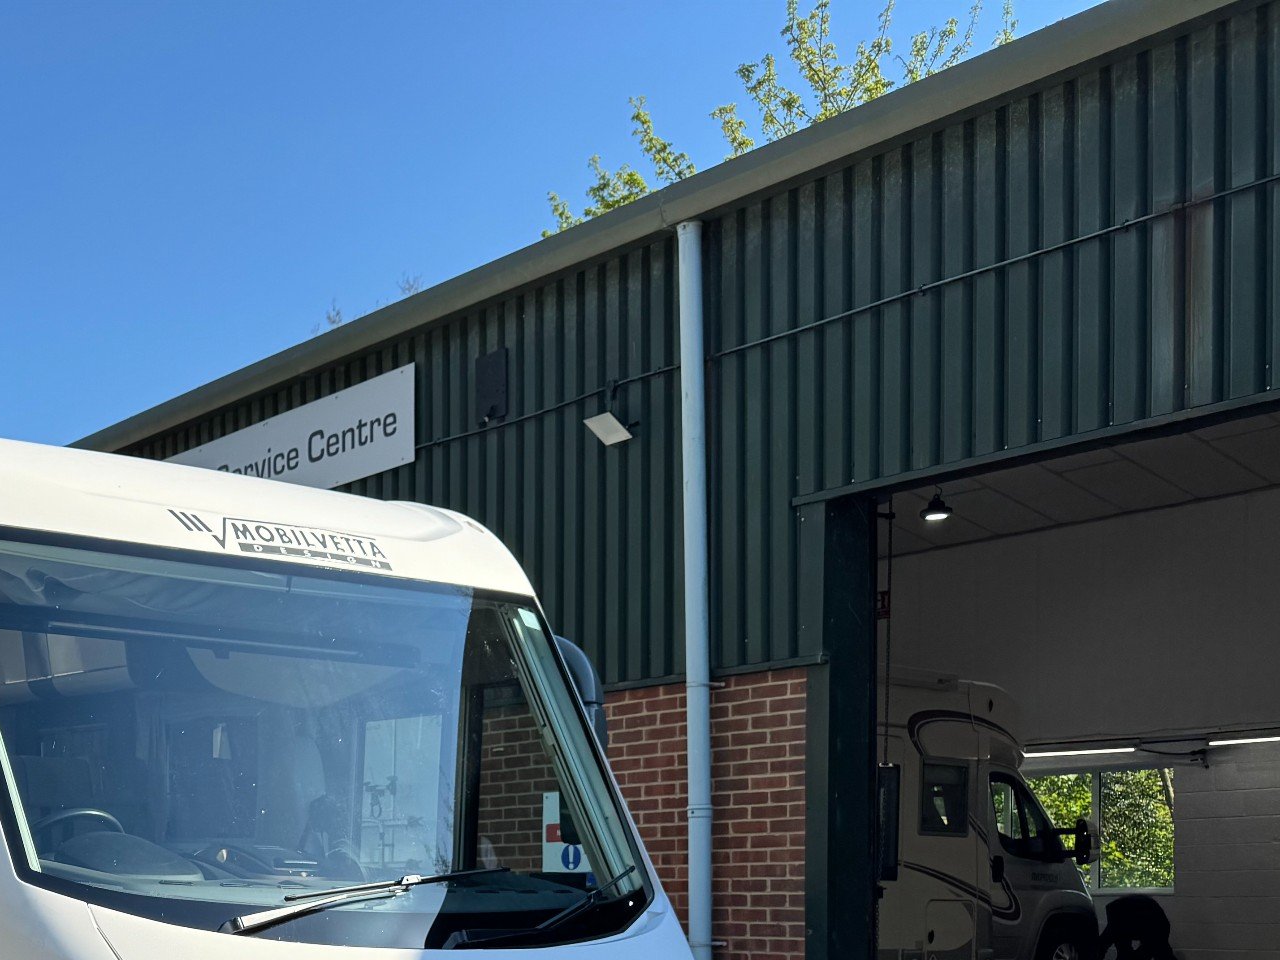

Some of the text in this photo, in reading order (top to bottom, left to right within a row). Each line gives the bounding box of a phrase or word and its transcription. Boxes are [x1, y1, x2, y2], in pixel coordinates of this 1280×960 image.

[308, 412, 397, 463] Centre
[230, 522, 386, 559] MOBILVETTA
[255, 544, 381, 568] DESIGN
